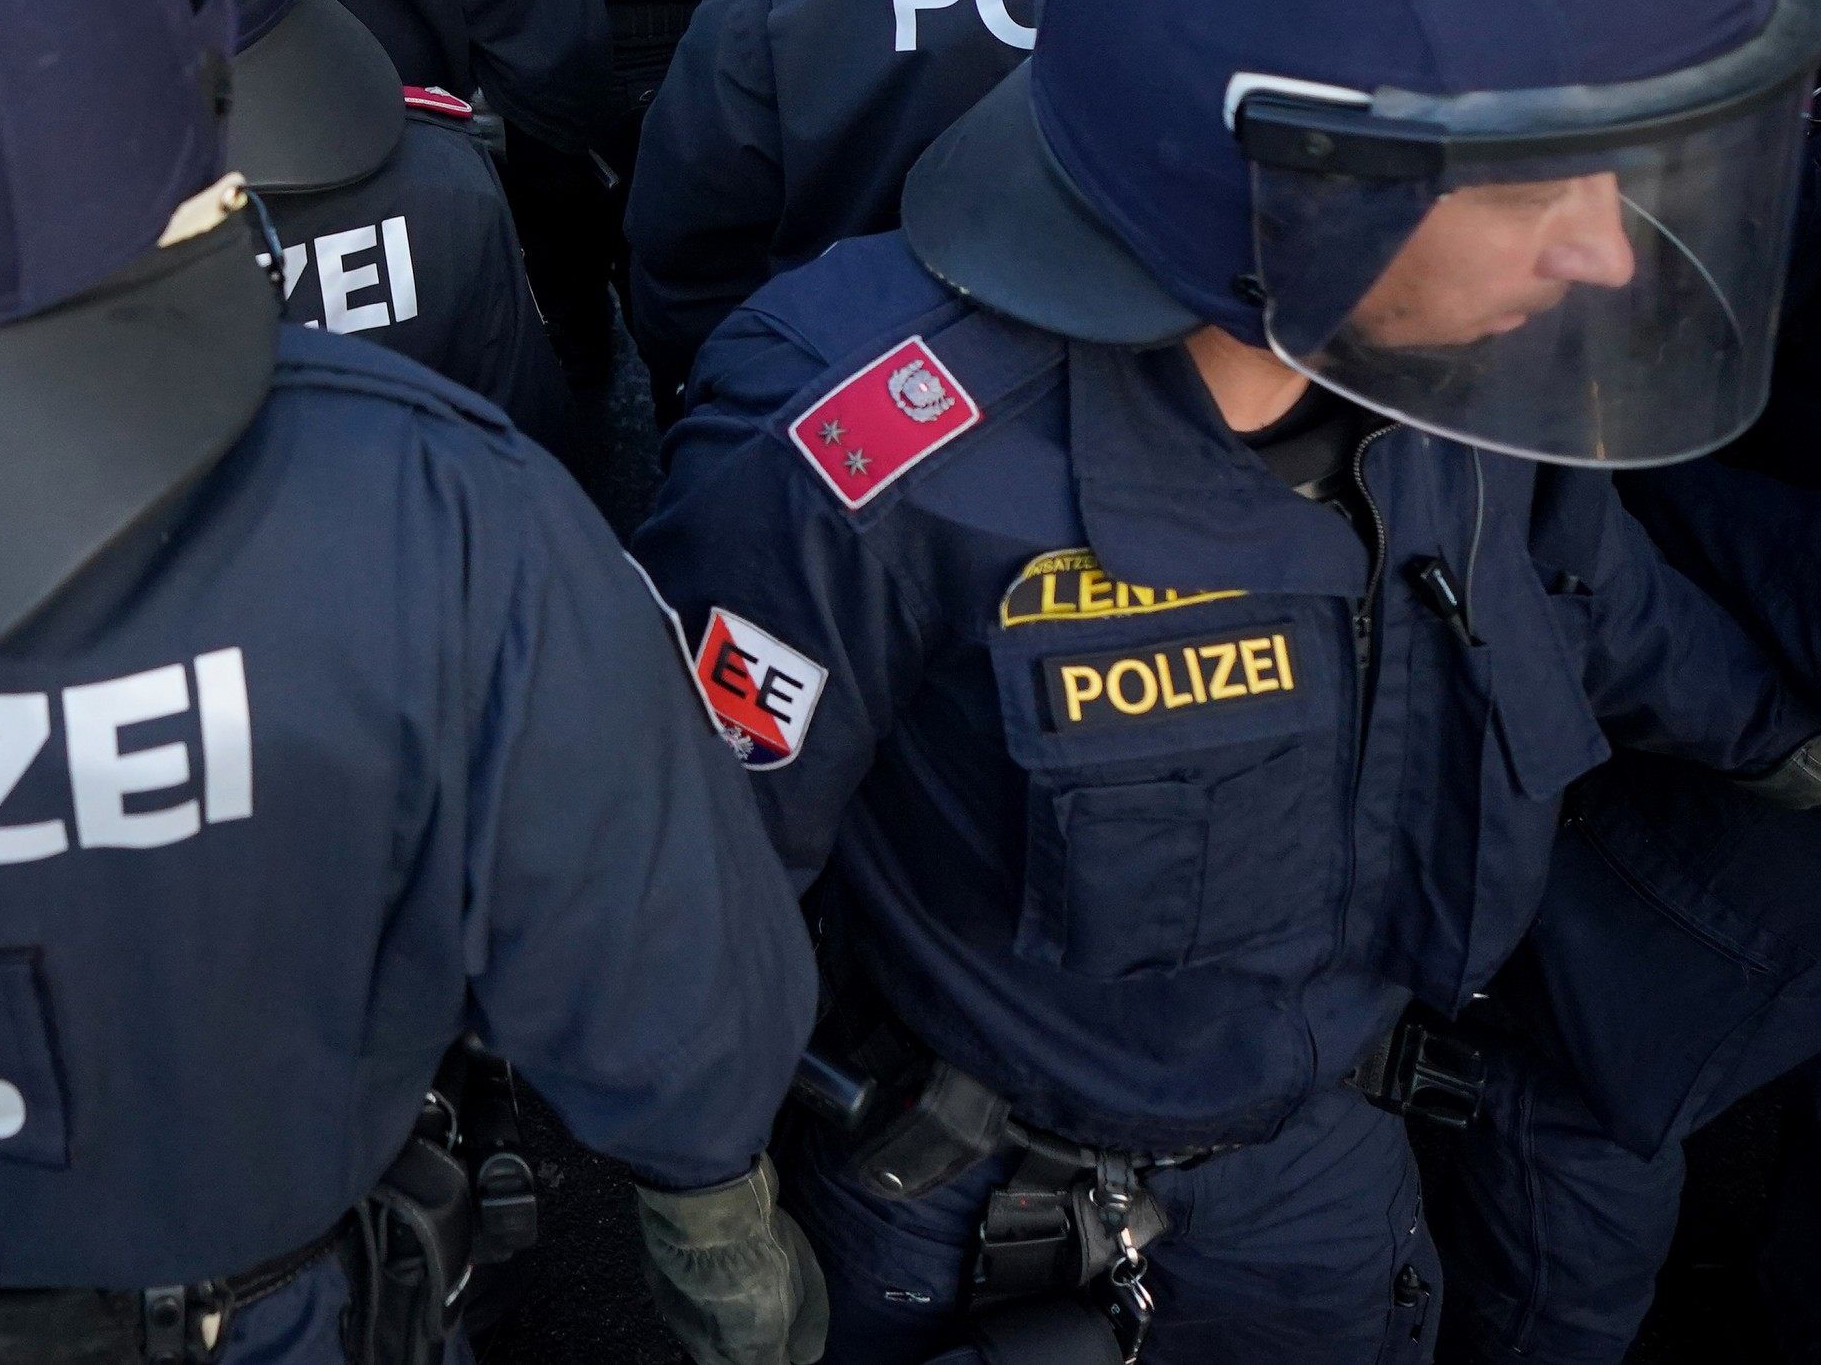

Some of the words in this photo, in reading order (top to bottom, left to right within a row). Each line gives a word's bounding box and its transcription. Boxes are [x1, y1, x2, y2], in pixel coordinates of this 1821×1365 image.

[1041, 568, 1179, 614] LEN
[711, 640, 804, 725] EE
[1061, 634, 1294, 722] POLIZEI
